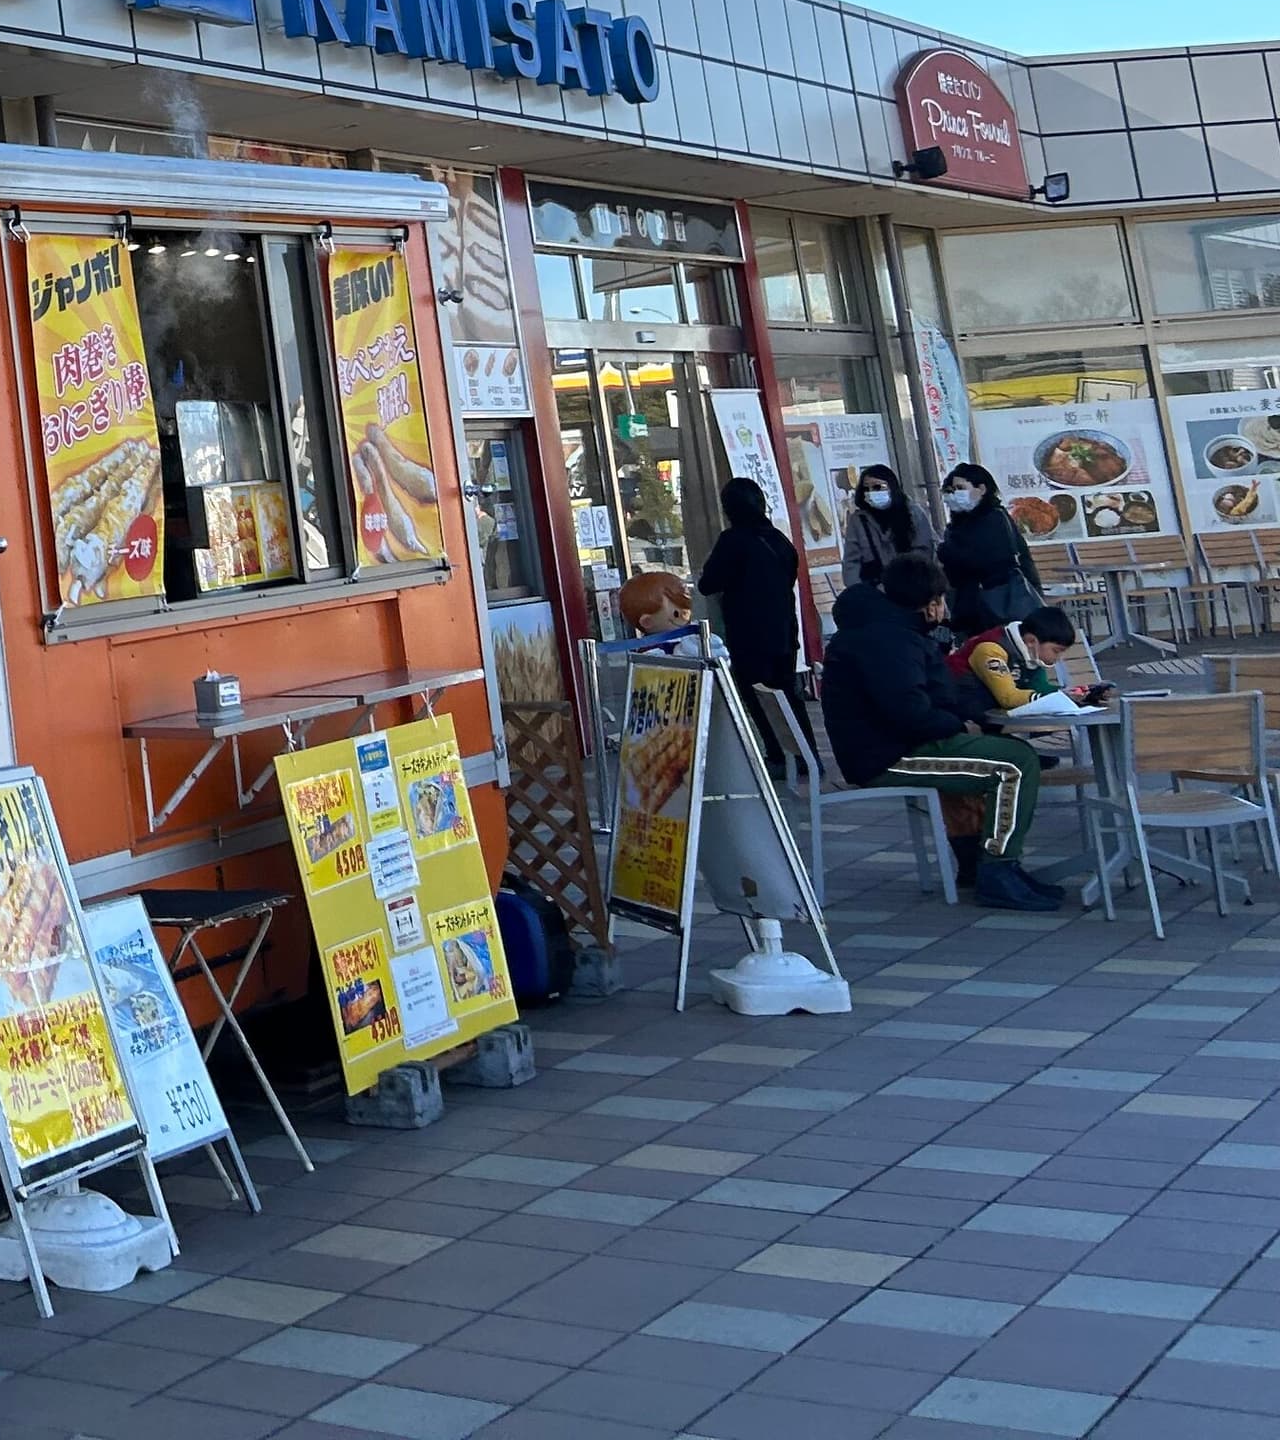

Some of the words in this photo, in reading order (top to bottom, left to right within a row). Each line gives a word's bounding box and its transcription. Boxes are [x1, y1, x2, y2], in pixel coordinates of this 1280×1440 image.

[921, 98, 968, 141] Prince
[53, 323, 118, 397] 肉巻き
[42, 362, 149, 455] おにぎり棒
[165, 1079, 212, 1131] ¥550
